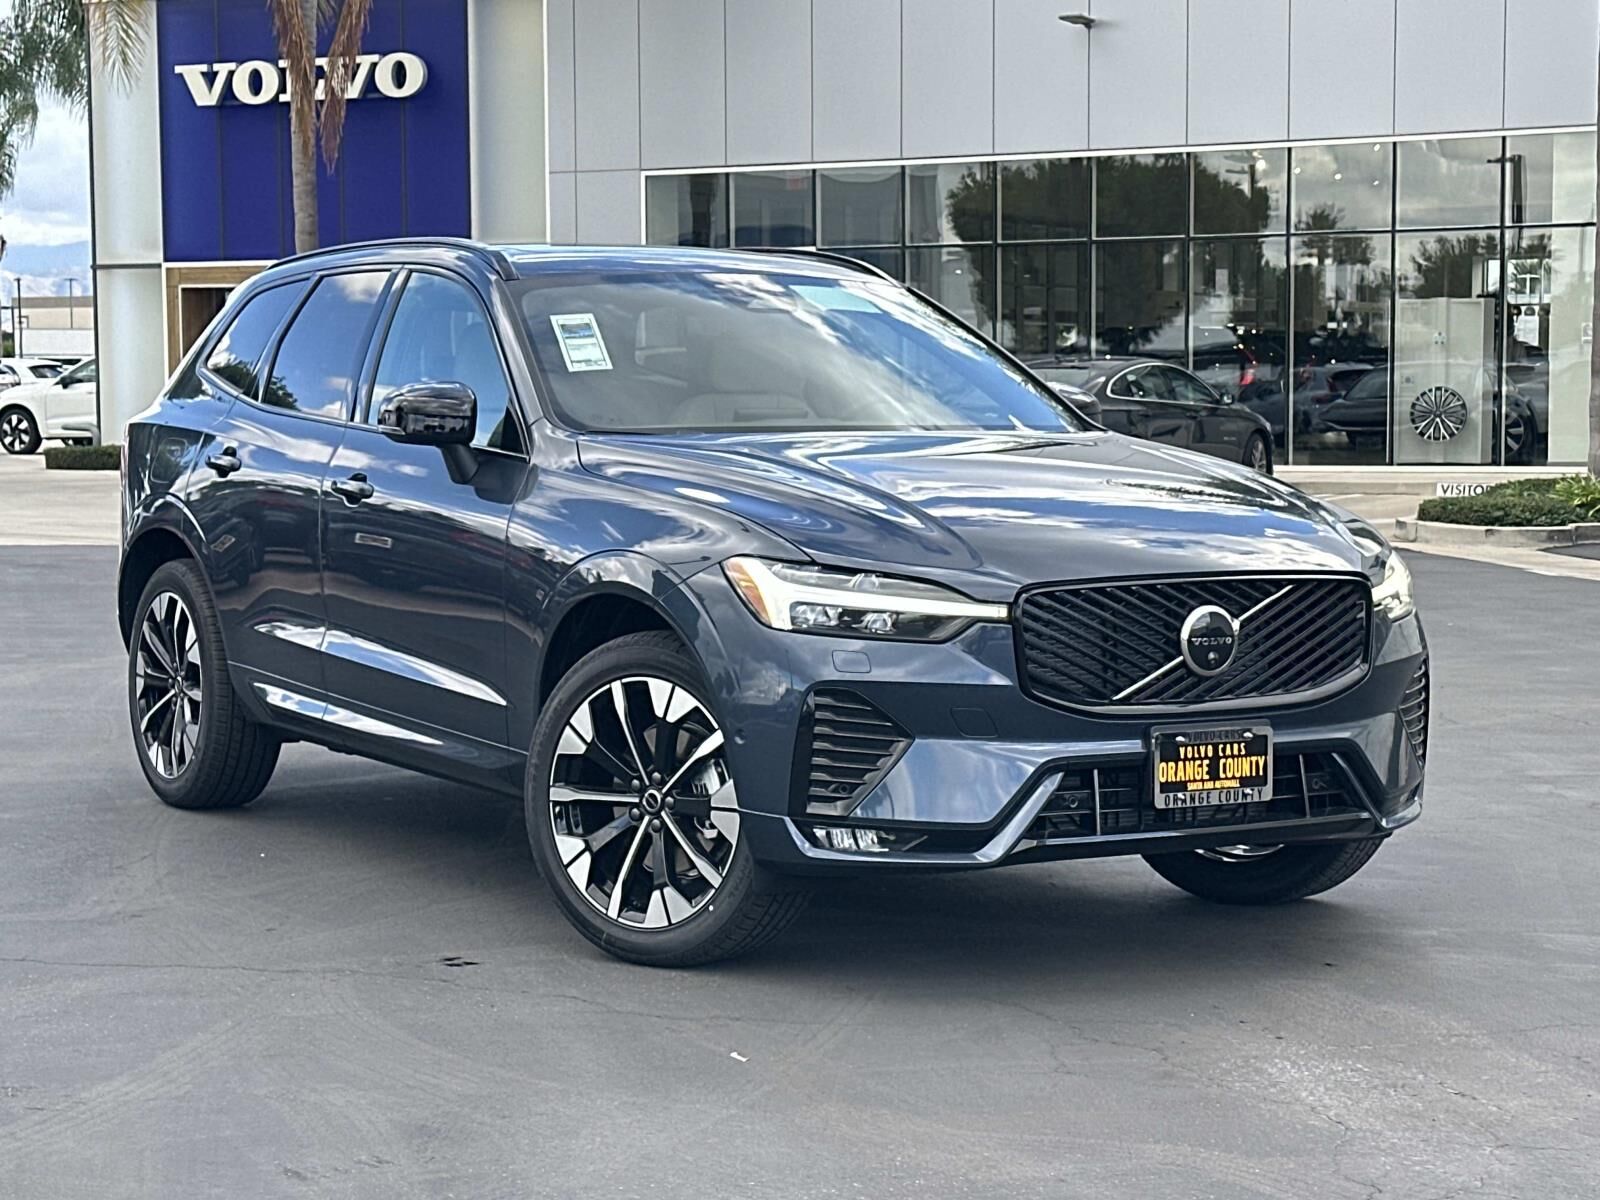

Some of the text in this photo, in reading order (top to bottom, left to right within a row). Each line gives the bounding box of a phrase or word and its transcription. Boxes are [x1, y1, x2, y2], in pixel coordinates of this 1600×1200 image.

[1191, 637, 1232, 646] VOLVO
[1179, 742, 1246, 759] VOLVO CARS
[1159, 755, 1265, 783] ORANGE COUNTY
[1164, 788, 1263, 807] ORANGE COUNTY
